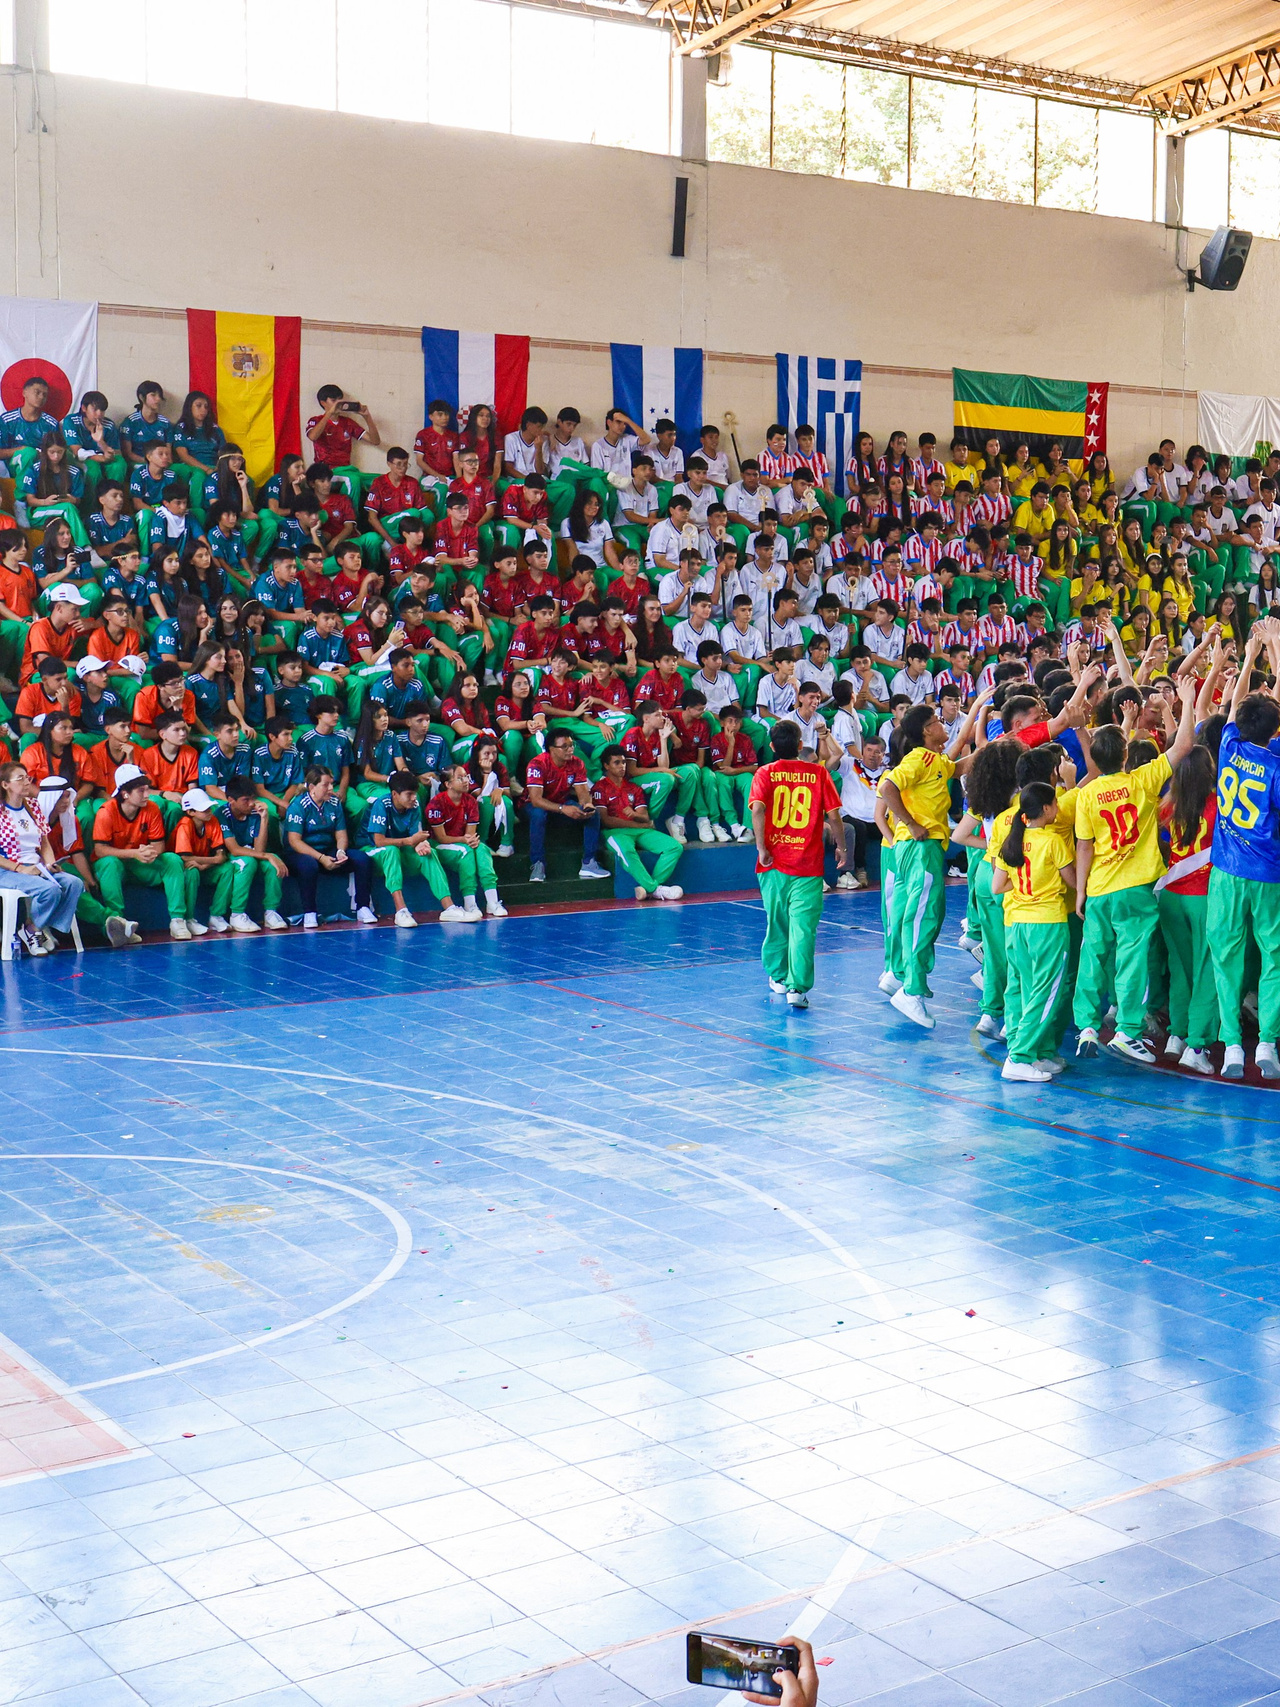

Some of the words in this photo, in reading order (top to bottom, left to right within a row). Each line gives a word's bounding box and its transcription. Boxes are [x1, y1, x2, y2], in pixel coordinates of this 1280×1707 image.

[158, 635, 176, 646] 8-02
[769, 771, 817, 784] SAMUELITO
[772, 785, 812, 829] 08
[1099, 802, 1140, 851] 10
